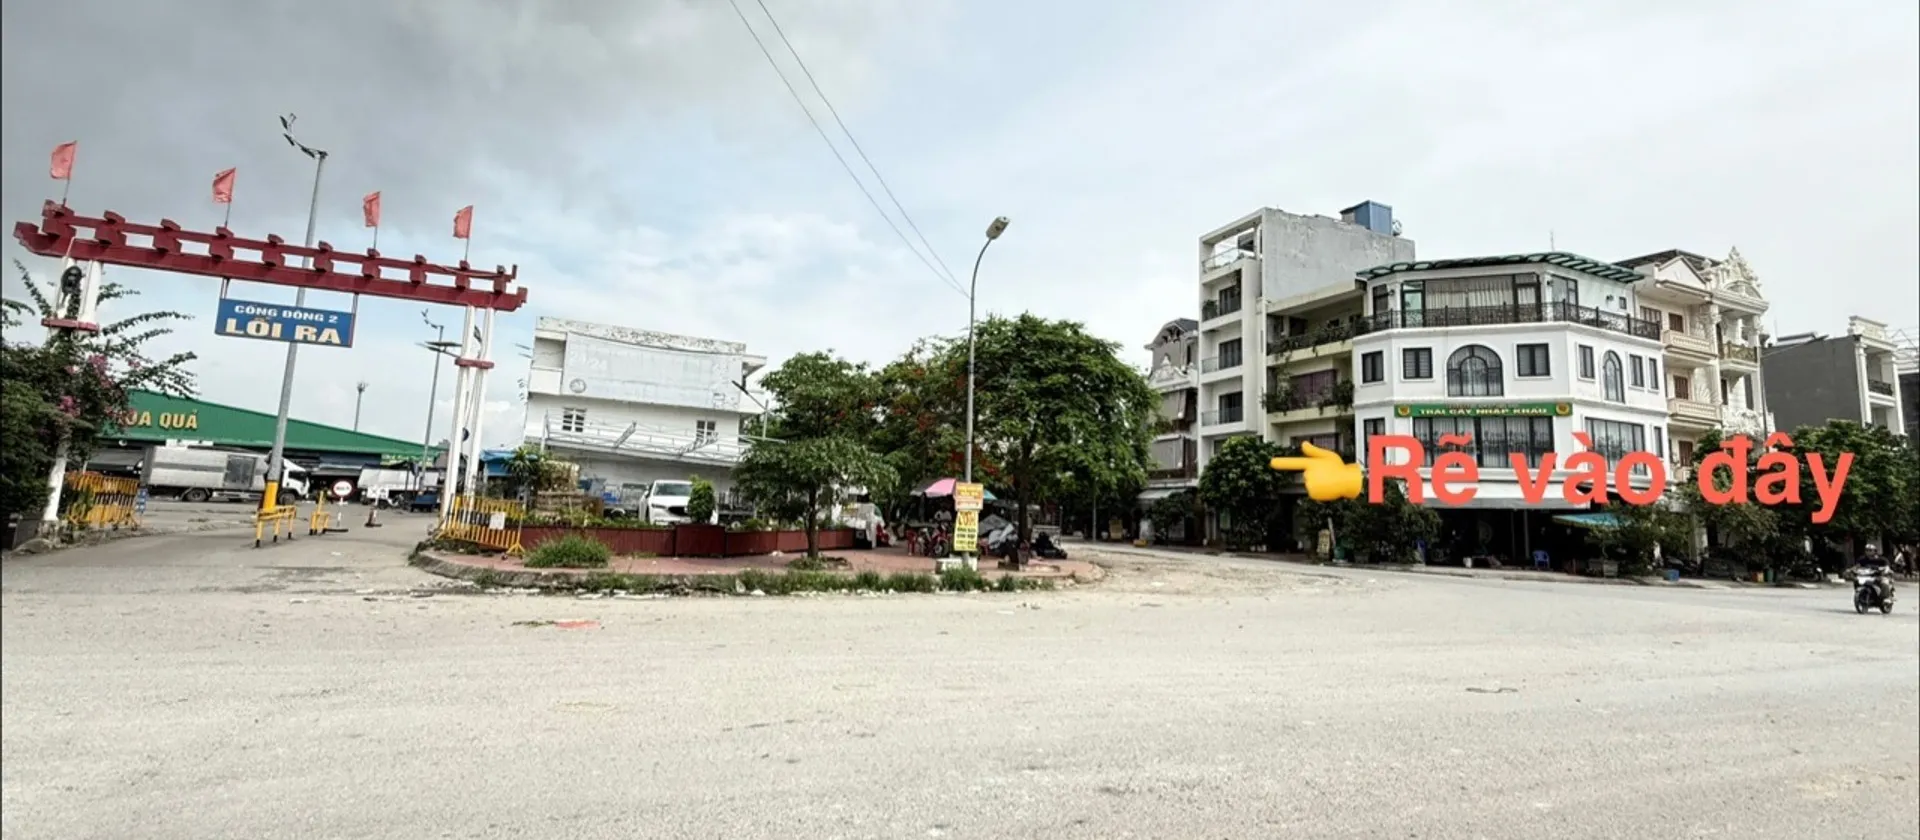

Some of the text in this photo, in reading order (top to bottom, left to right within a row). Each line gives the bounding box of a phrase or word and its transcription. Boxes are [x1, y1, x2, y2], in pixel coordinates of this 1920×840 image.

[328, 314, 338, 324] 2
[225, 316, 341, 344] LỐI RA
[116, 408, 198, 429] OA QUẢ
